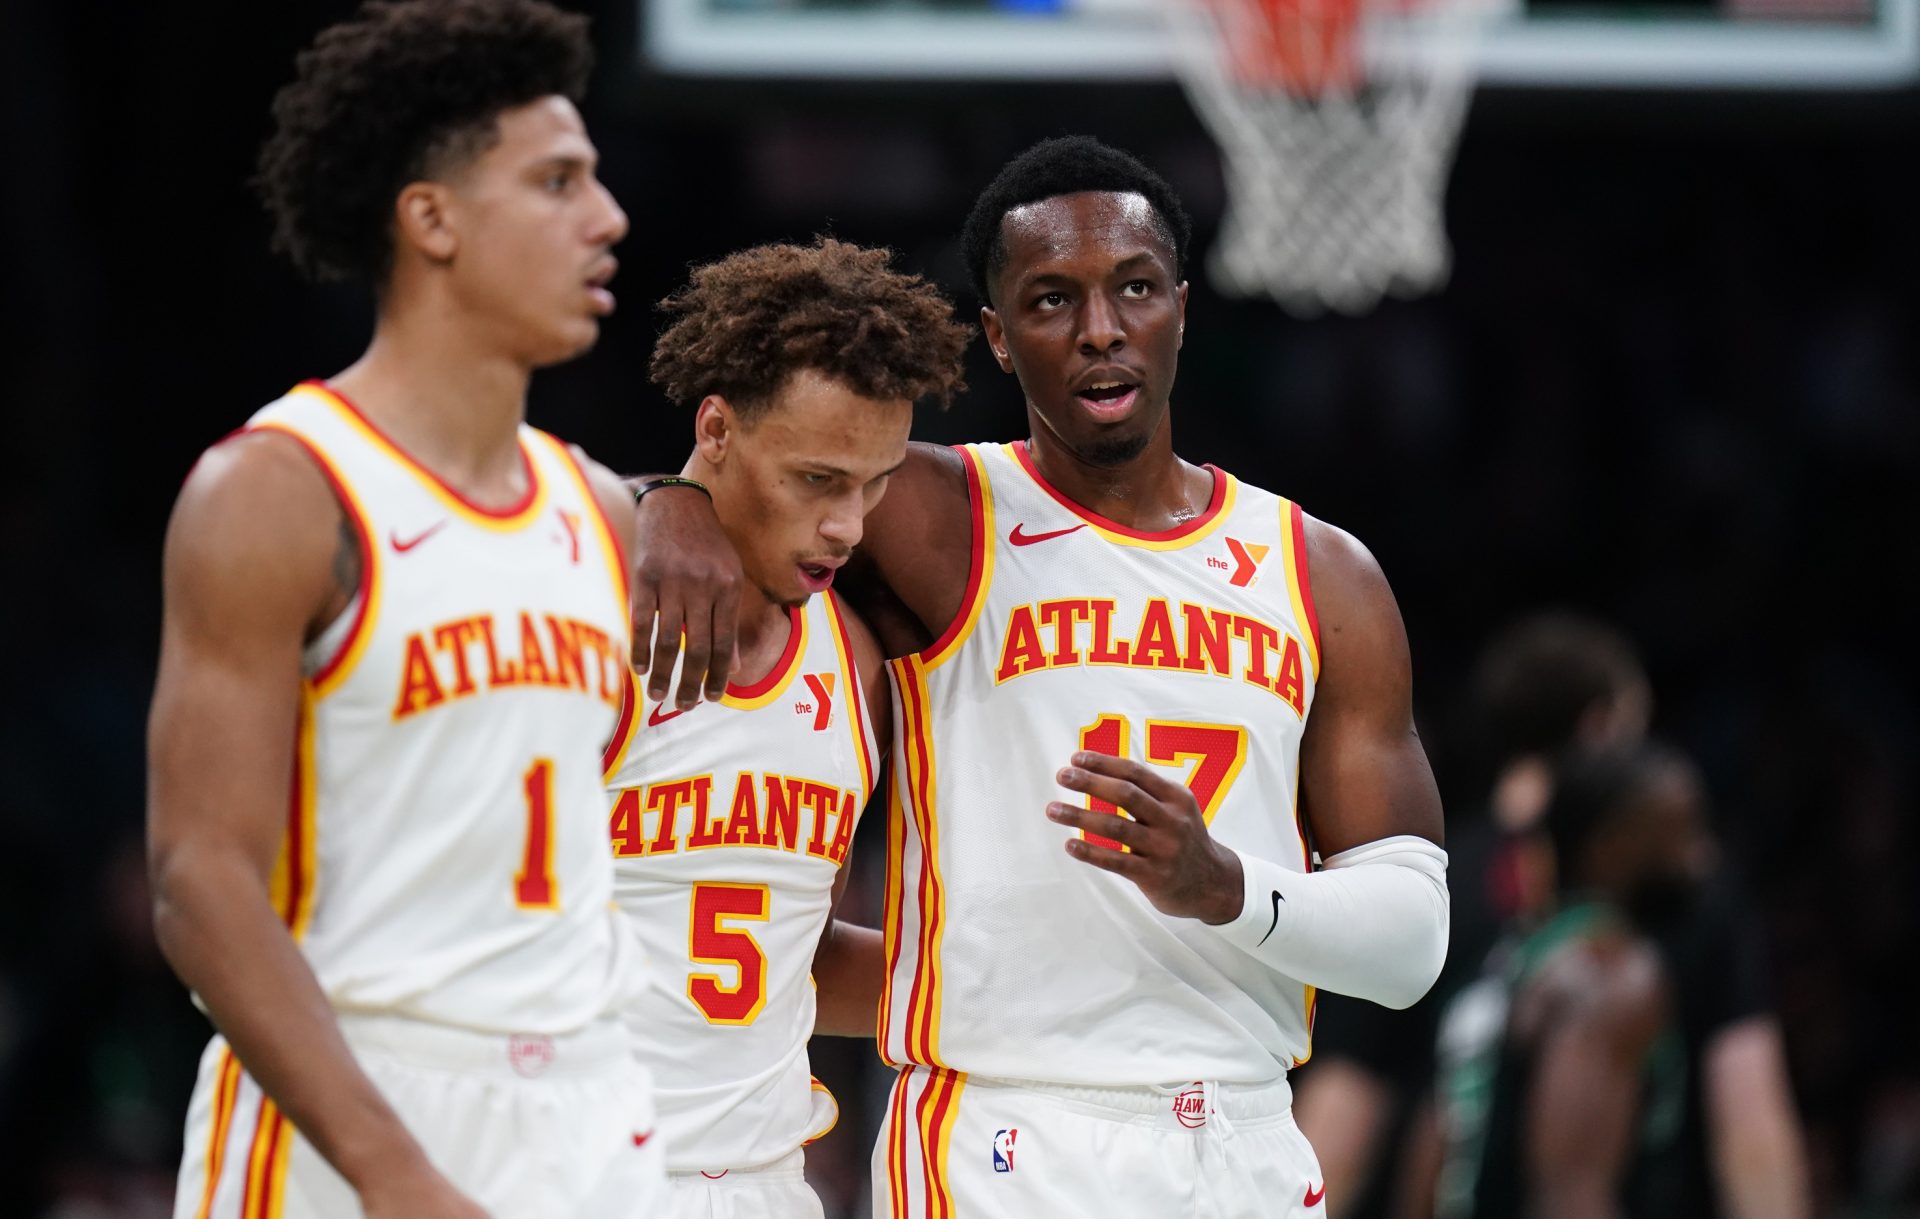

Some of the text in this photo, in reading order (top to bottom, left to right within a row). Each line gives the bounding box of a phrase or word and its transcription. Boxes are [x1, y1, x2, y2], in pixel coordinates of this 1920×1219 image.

[1206, 536, 1270, 587] the Y
[392, 610, 622, 723] ATLANT
[795, 672, 835, 731] the Y
[995, 597, 1306, 721] ATLANTA
[514, 758, 559, 910] 1
[608, 771, 856, 868] ATLANTA
[1079, 713, 1248, 855] 17
[687, 881, 770, 1026] 5
[1172, 1096, 1215, 1115] HAW
